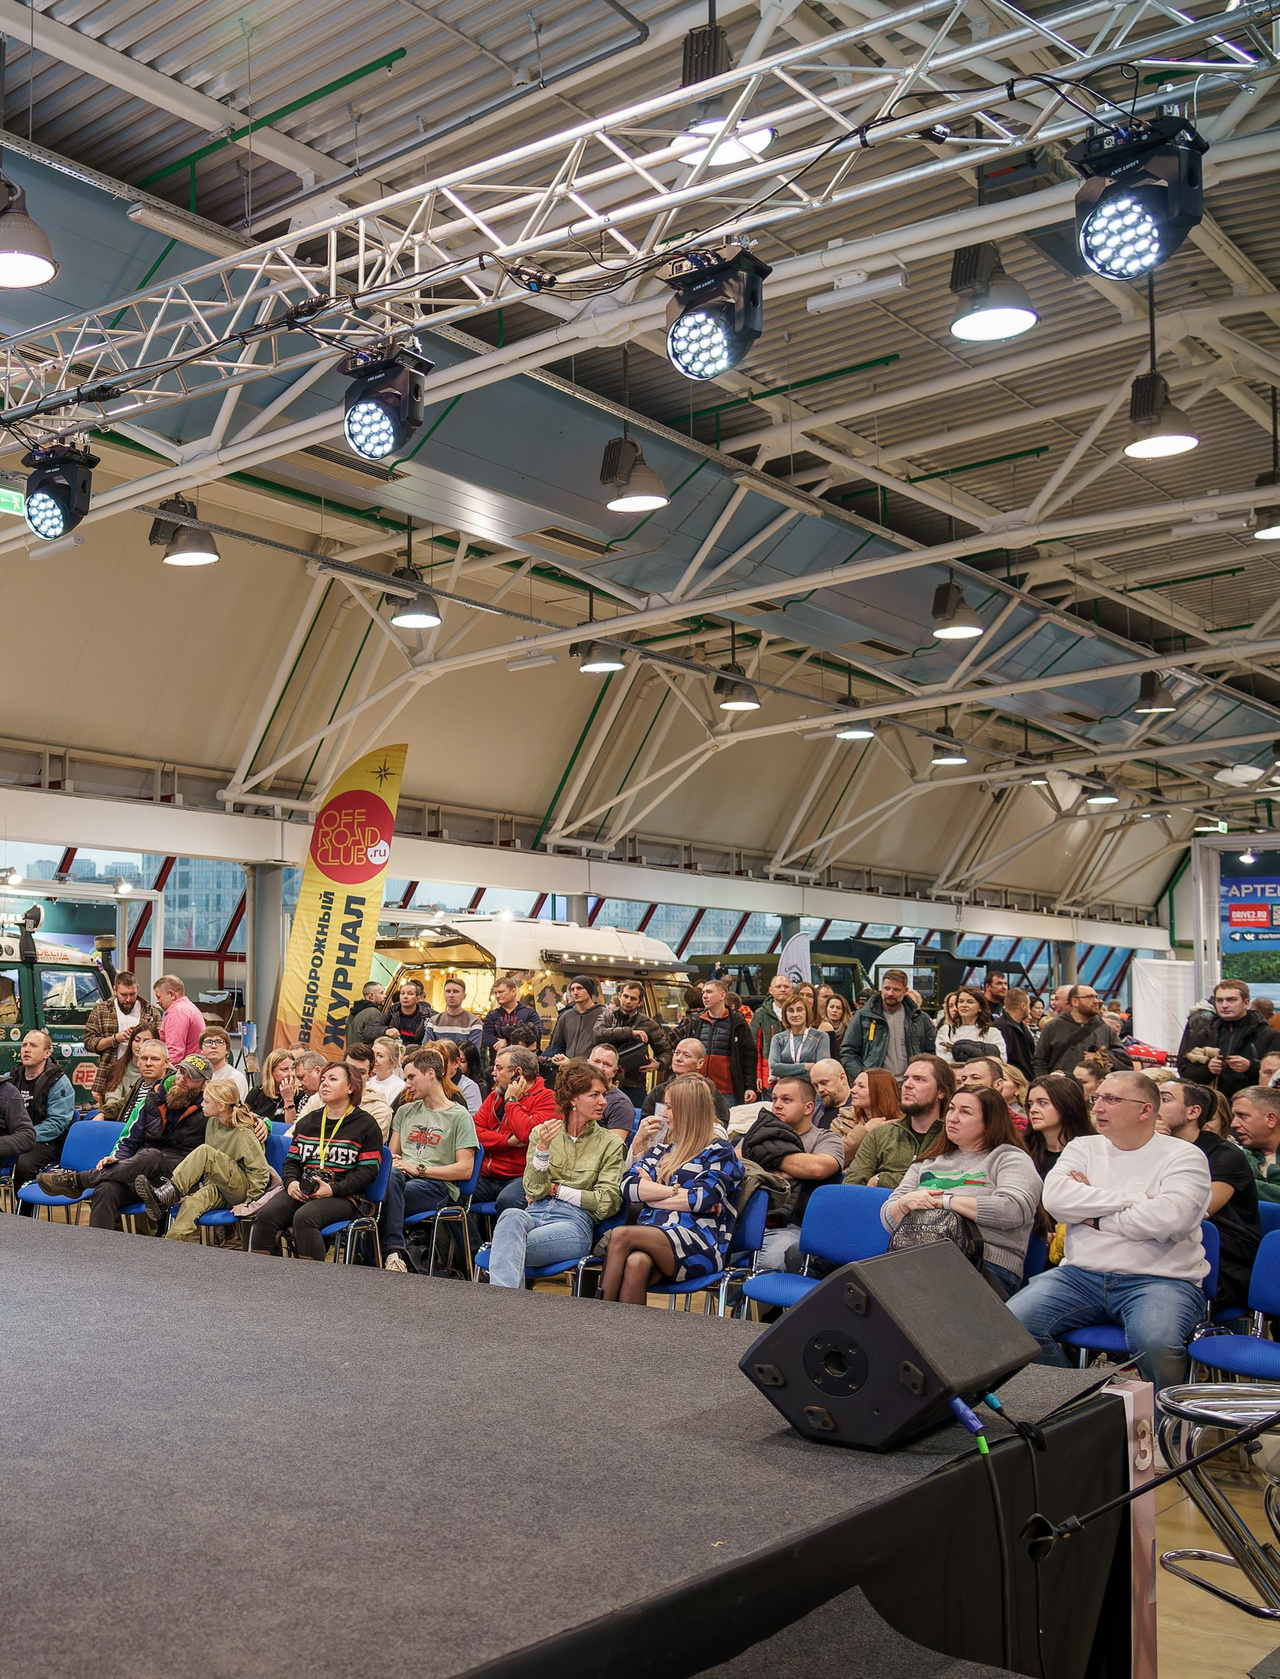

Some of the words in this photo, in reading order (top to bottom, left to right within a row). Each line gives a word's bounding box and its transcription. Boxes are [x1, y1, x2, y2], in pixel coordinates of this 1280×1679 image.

[321, 808, 367, 830] OFF
[317, 827, 381, 849] ROAD
[316, 845, 367, 866] CLUB
[370, 848, 387, 858] .ru
[298, 891, 335, 1043] ВНЕДОРОЖНЫЙ
[323, 894, 366, 1050] ЖУРНАЛ
[75, 1070, 96, 1083] RE
